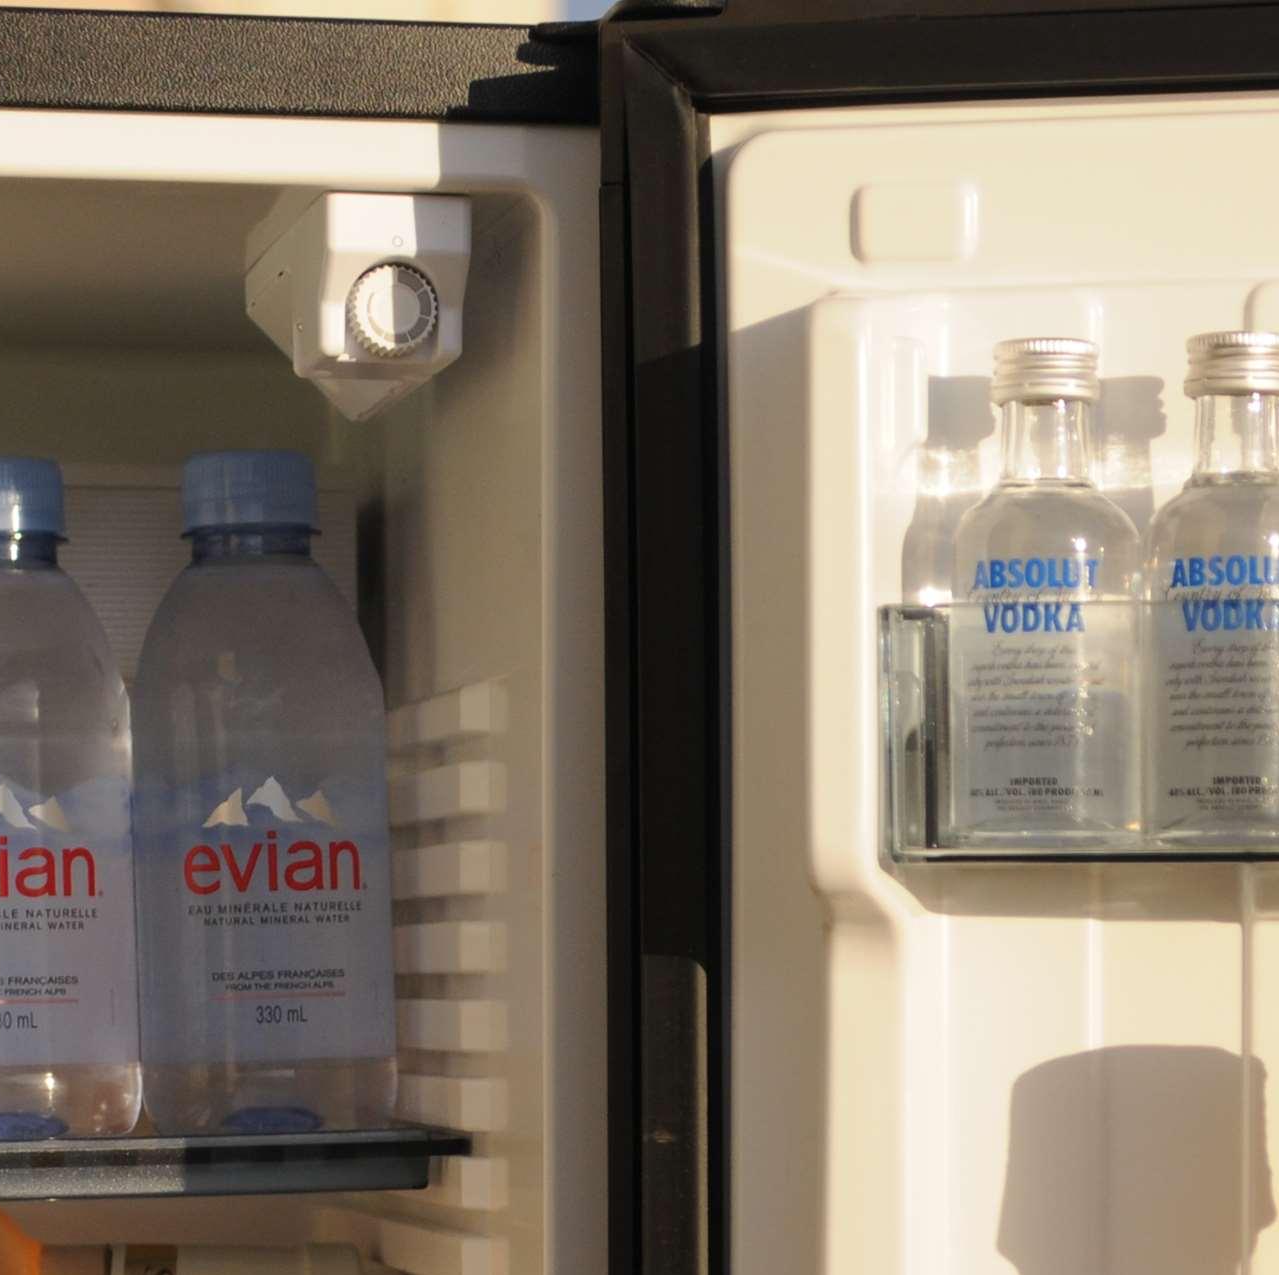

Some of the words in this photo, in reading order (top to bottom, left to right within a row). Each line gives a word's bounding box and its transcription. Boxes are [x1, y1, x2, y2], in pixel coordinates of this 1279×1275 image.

[975, 558, 1100, 590] ABSOLUT
[983, 602, 1086, 634] VODKA
[183, 831, 361, 896] evian
[25, 906, 99, 919] NATURELLE
[188, 904, 213, 916] EAU
[294, 900, 363, 913] NATURELLE
[48, 920, 86, 931] WATER
[203, 915, 256, 928] NATURAL
[260, 914, 311, 926] MINERAL
[315, 913, 351, 925] WATER
[7, 974, 80, 988] FRANÇAISES
[211, 971, 235, 983] DES
[238, 969, 274, 982] ALPES
[277, 967, 346, 981] FRANÇAISES
[4, 986, 43, 997] FRENCH
[254, 981, 272, 992] THE
[273, 980, 312, 992] FRENCH
[16, 1010, 38, 1030] mL
[256, 1004, 282, 1024] 330
[287, 1004, 308, 1023] mL
